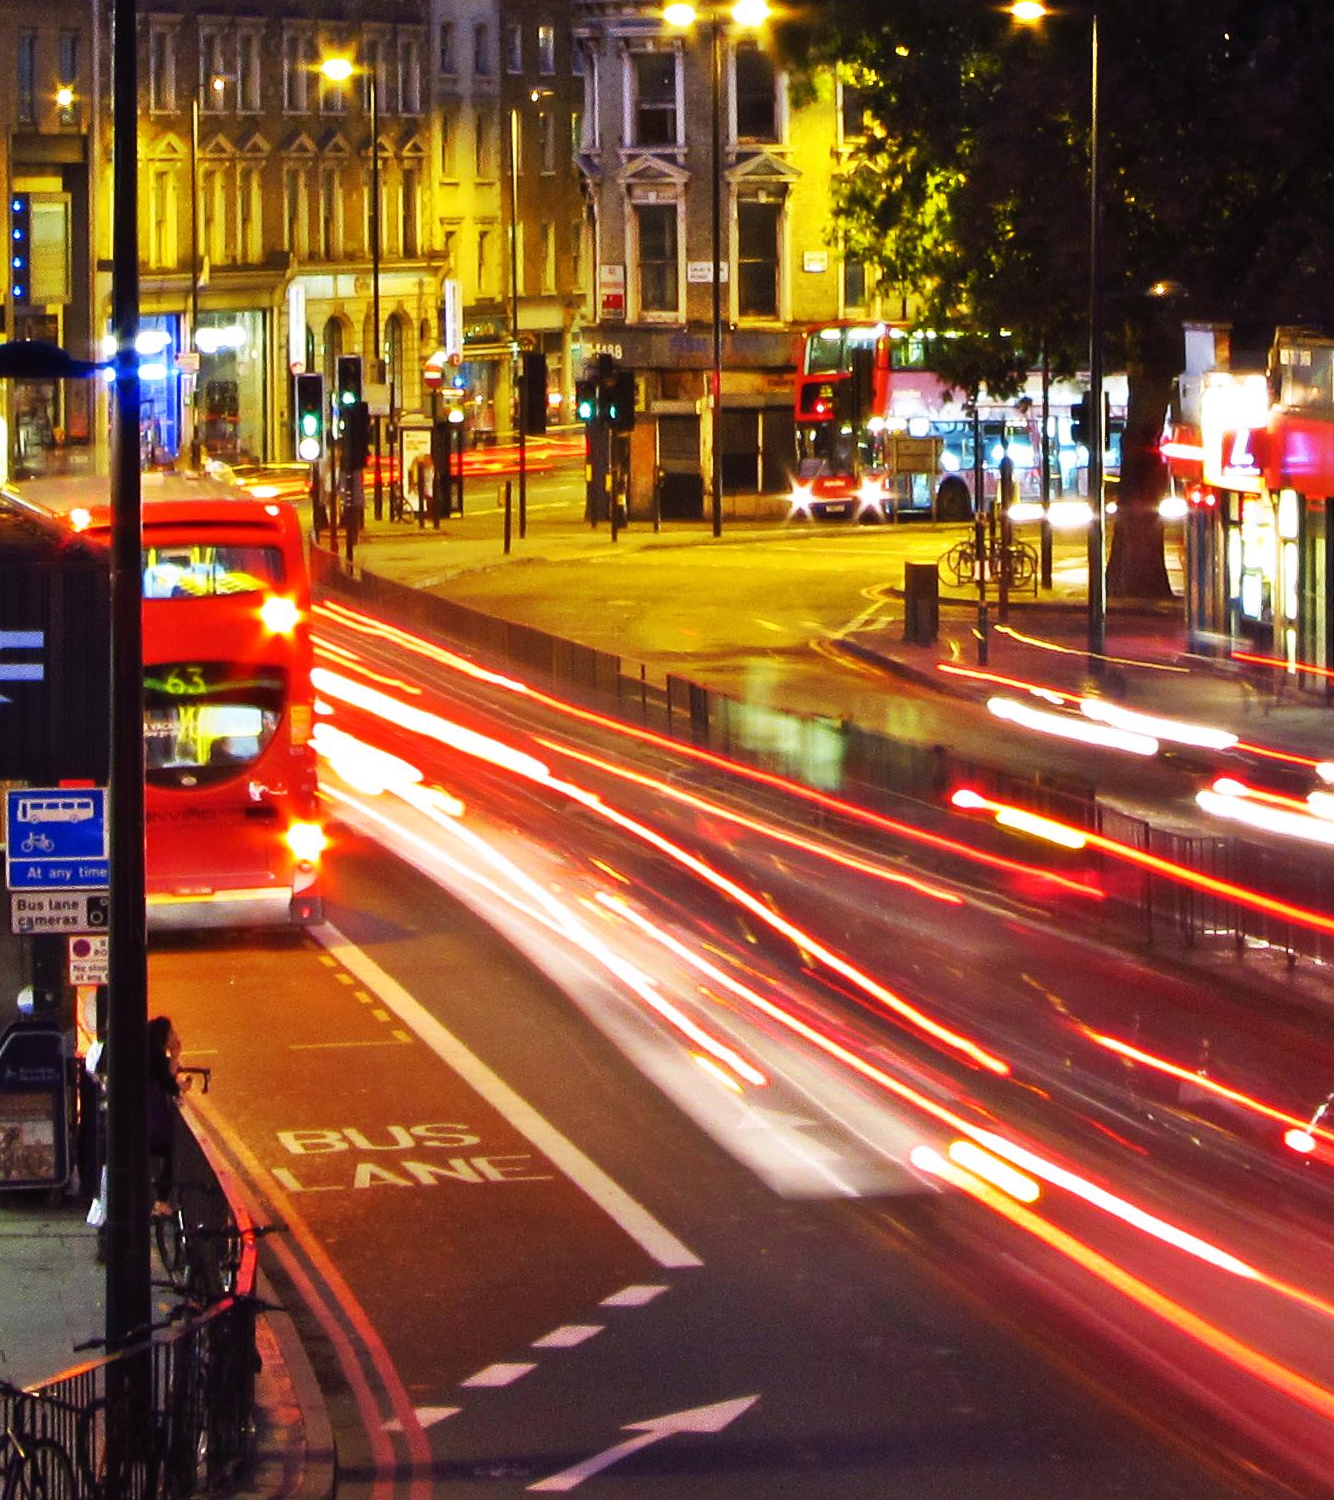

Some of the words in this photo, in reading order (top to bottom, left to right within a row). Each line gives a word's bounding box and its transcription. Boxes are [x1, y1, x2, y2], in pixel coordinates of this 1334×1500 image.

[27, 866, 43, 879] At
[49, 868, 73, 881] any
[17, 899, 44, 911] Bus
[48, 898, 79, 911] lane
[18, 915, 79, 926] cameras
[277, 1123, 482, 1155] BUS
[271, 1154, 555, 1192] LANE
